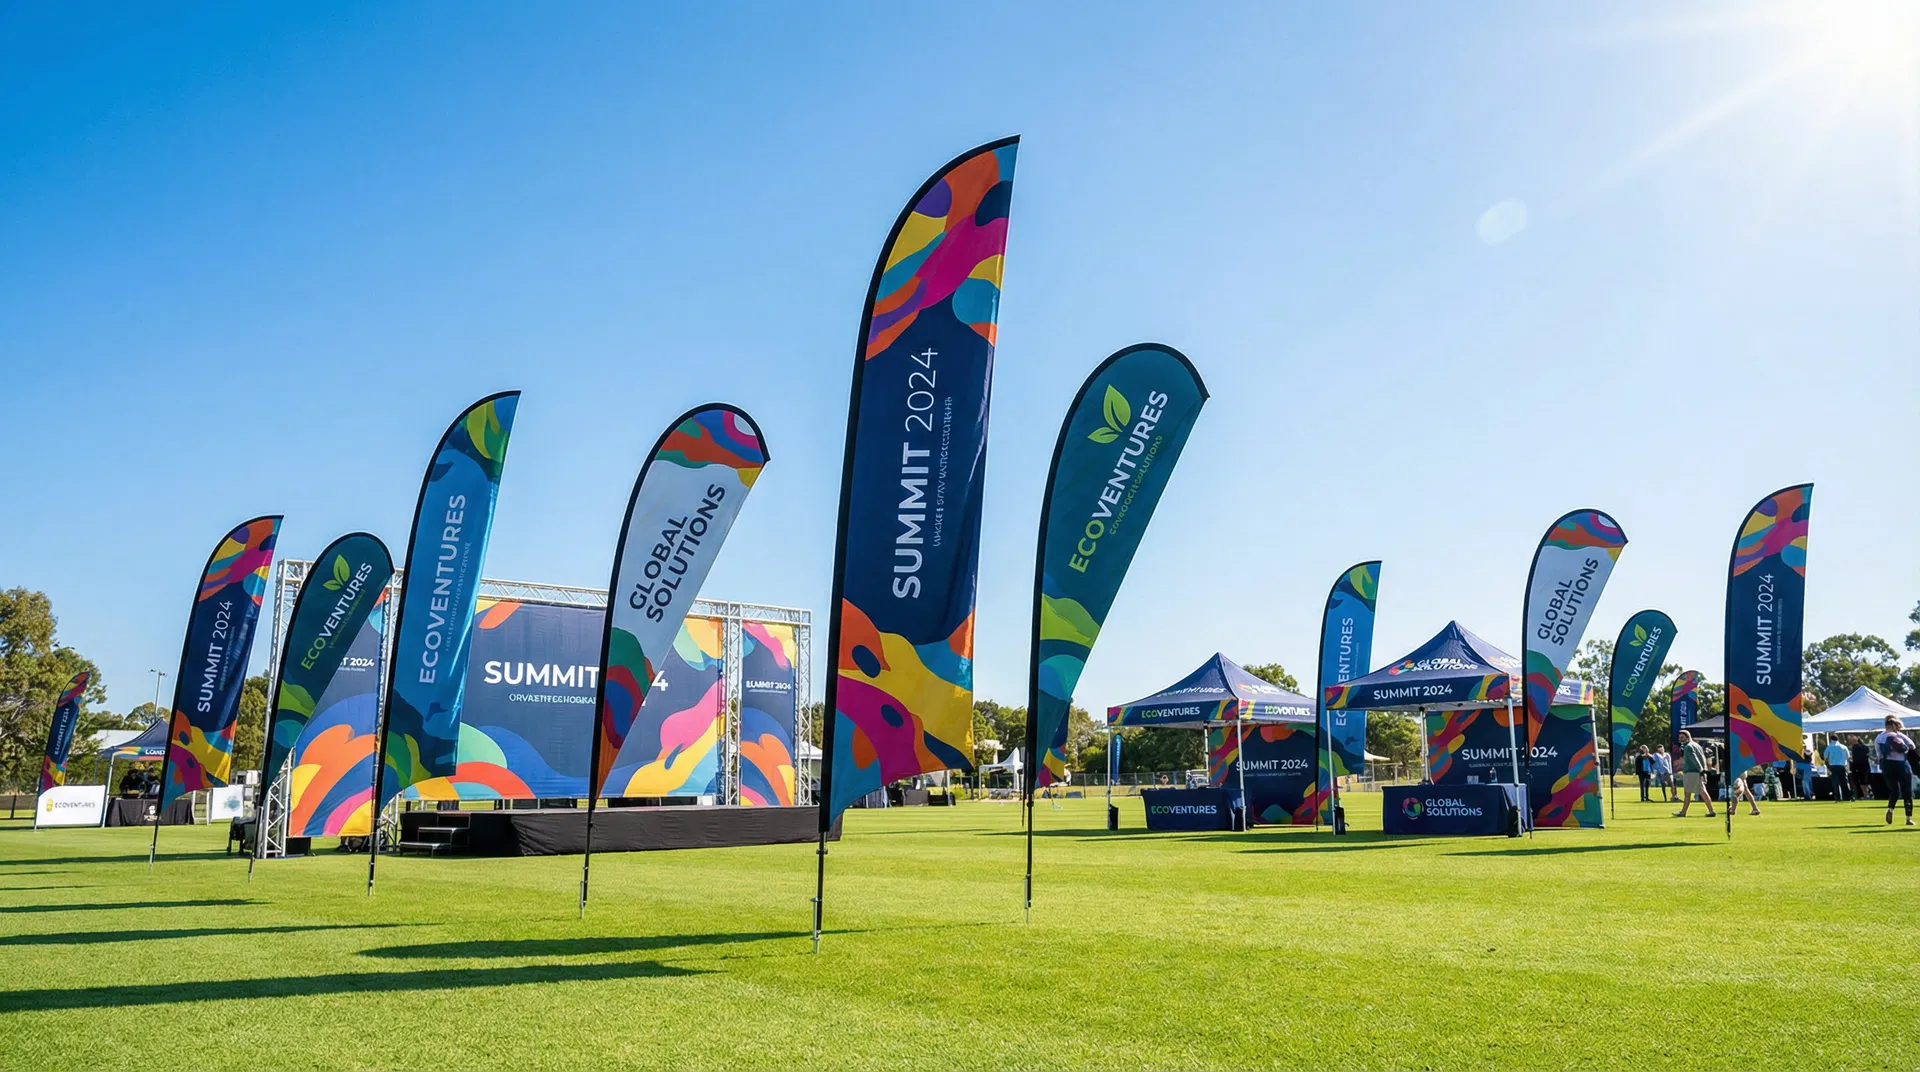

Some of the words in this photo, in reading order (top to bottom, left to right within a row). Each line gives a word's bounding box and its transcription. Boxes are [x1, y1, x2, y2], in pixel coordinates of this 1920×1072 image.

[904, 347, 938, 432] 2024
[1068, 390, 1168, 574] ECOVENTURES
[646, 483, 726, 623] SOLUTIONS
[892, 442, 931, 599] SUMMIT
[419, 494, 466, 684] ECOVENTURES
[629, 516, 688, 610] GLOBAL
[1757, 573, 1774, 612] 2024
[301, 562, 372, 670] ECOVENTURES
[1537, 580, 1573, 639] GLOBAL
[1551, 557, 1599, 646] SOLUTIONS
[197, 642, 223, 713] SUMMIT
[212, 600, 233, 640] 2024
[484, 660, 600, 689] SUMMIT
[1622, 626, 1662, 698] ECOVENTURES
[1756, 615, 1772, 685] SUMMIT
[1141, 706, 1200, 719] ECOVENTURES
[1373, 686, 1420, 700] SUMMIT
[1423, 684, 1453, 696] 2024
[1236, 759, 1279, 771] SUMMIT
[1281, 759, 1308, 770] 2024
[1151, 805, 1217, 815] ECOVENTURES
[1425, 798, 1465, 807] GLOBAL
[1426, 807, 1483, 817] SOLUTIONS
